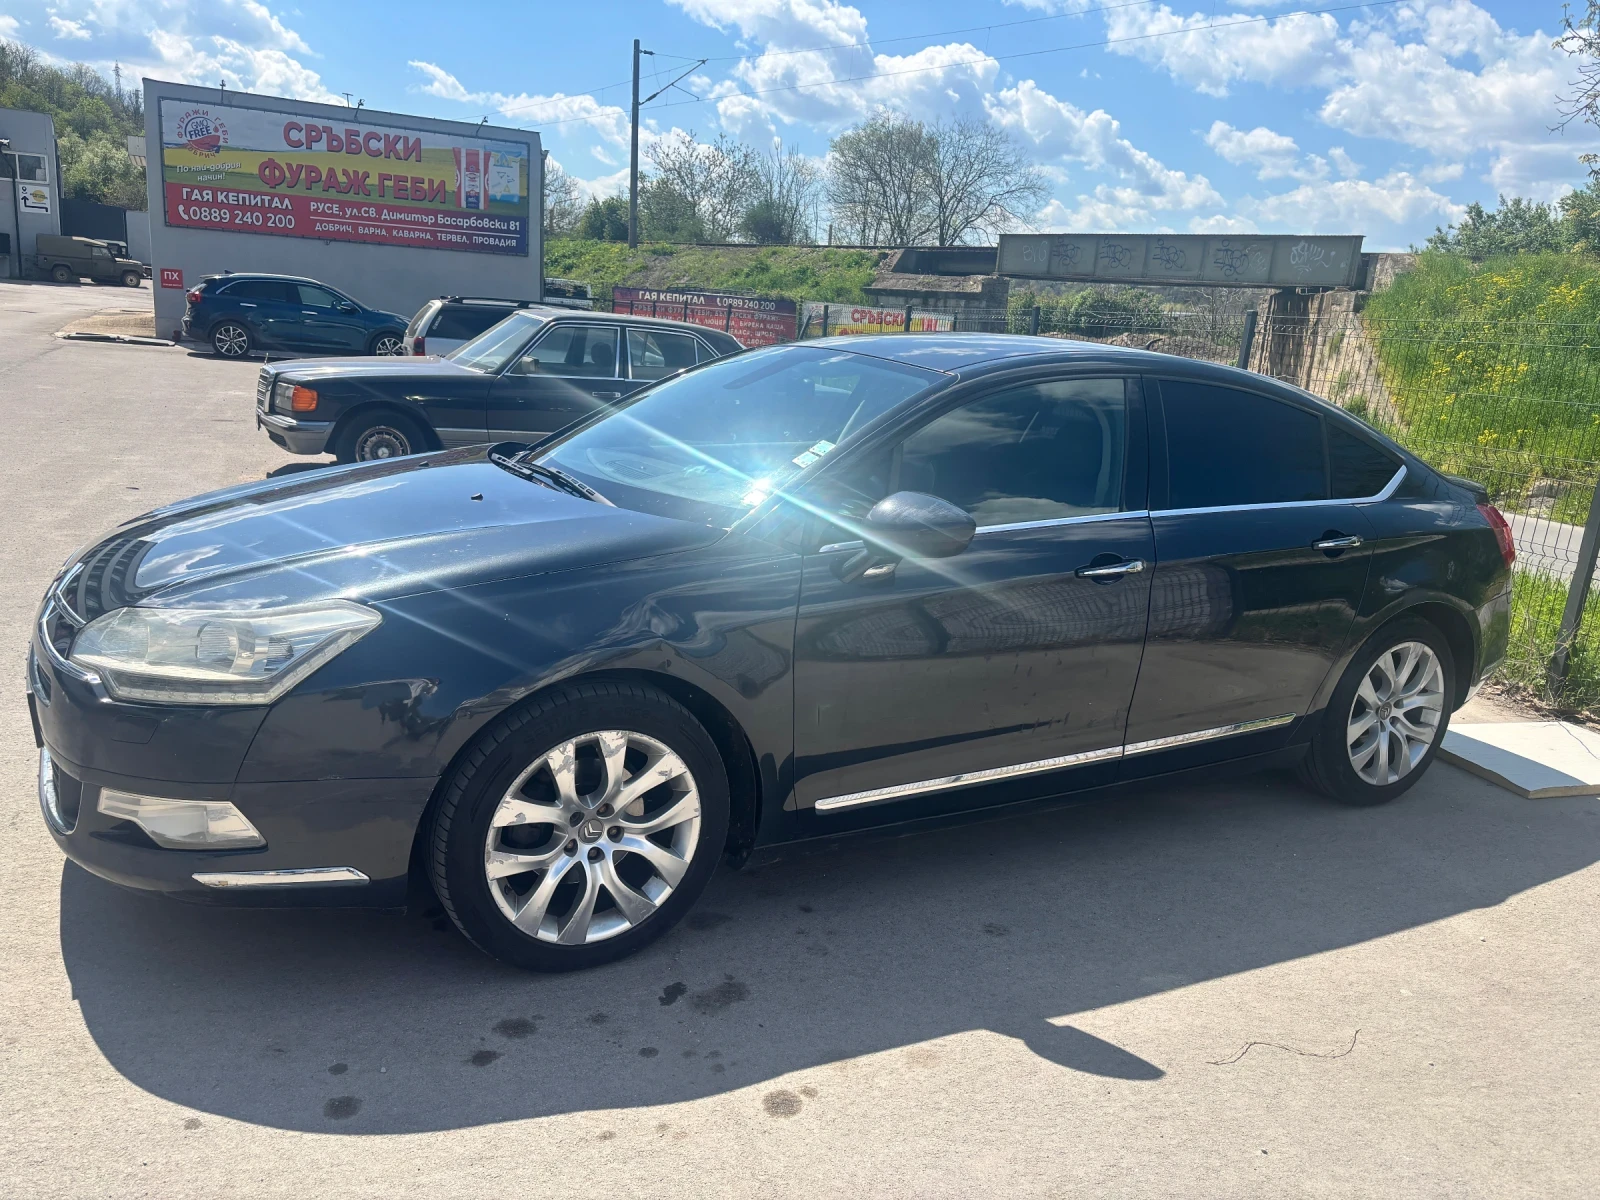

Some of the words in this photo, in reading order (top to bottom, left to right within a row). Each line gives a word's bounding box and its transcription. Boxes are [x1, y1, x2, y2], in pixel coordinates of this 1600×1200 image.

[191, 118, 208, 129] GMO
[188, 126, 212, 139] FREE
[283, 121, 421, 162] СРЪБСКИ
[177, 165, 189, 173] По
[191, 162, 242, 172] най-добрия
[197, 173, 226, 182] начин!
[258, 158, 370, 197] ФУРАЖ
[377, 172, 446, 204] ГЕБИ
[182, 188, 213, 202] ГАЯ
[217, 191, 293, 210] КЕПИТАЛ
[190, 206, 230, 222] 0889
[234, 210, 263, 225] 240
[267, 213, 296, 229] 200
[310, 201, 343, 216] РУСЕ,
[381, 209, 435, 224] Димитър
[437, 214, 508, 230] Басарбовски
[509, 220, 520, 230] 81
[315, 222, 355, 234] ДОБРИЧ,
[358, 226, 389, 237] ВАРНА,
[392, 229, 433, 240] КАВАРНА,
[437, 233, 470, 244] ТЕРВЕЛ,
[473, 236, 517, 247] ПРОВАДИЯ
[164, 271, 180, 281] ПХ
[638, 290, 658, 301] ГАЯ
[660, 292, 705, 305] КЕПИТАЛ
[744, 300, 759, 309] 240
[760, 301, 776, 311] 200
